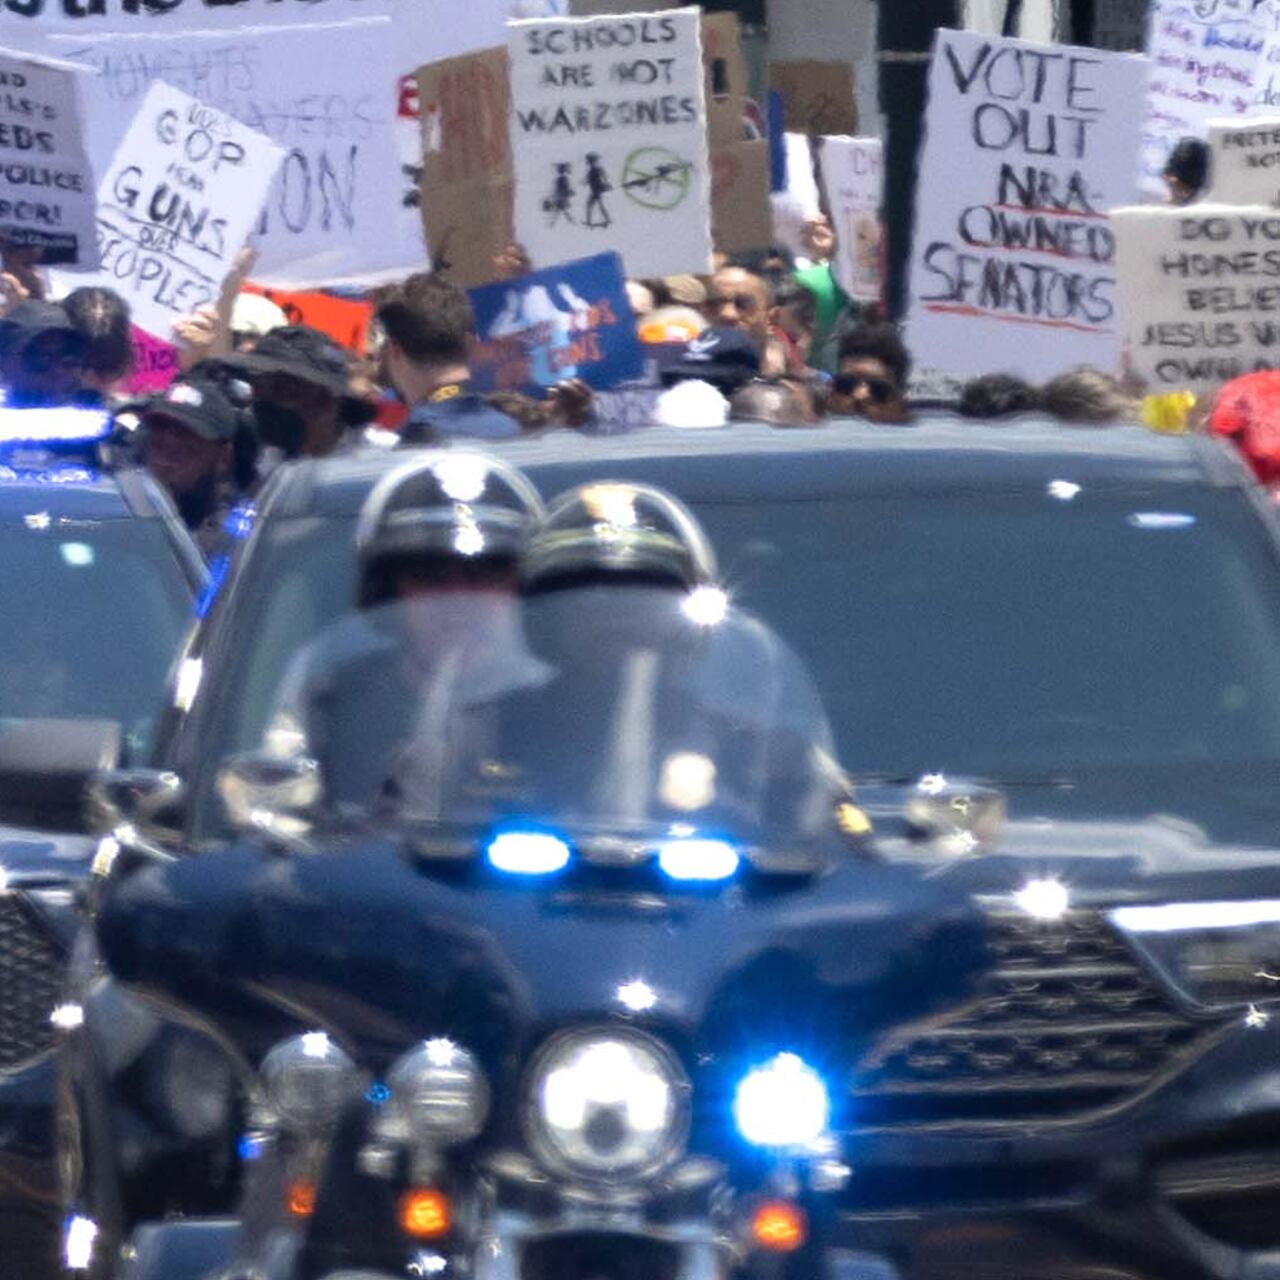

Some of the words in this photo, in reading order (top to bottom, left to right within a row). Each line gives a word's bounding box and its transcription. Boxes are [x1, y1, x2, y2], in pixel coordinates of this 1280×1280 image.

[525, 18, 678, 56] SCHOOLS
[539, 65, 596, 89] ARE
[609, 57, 676, 85] NOT
[943, 42, 1104, 113] VOTE
[154, 109, 245, 174] GOP
[517, 96, 697, 135] WARZONES
[972, 102, 1099, 159] OUT
[112, 164, 229, 261] GUNS
[957, 204, 1117, 263] OWNED
[1179, 218, 1232, 242] DO
[920, 241, 1118, 324] SENATORS
[1141, 321, 1240, 350] JESUS
